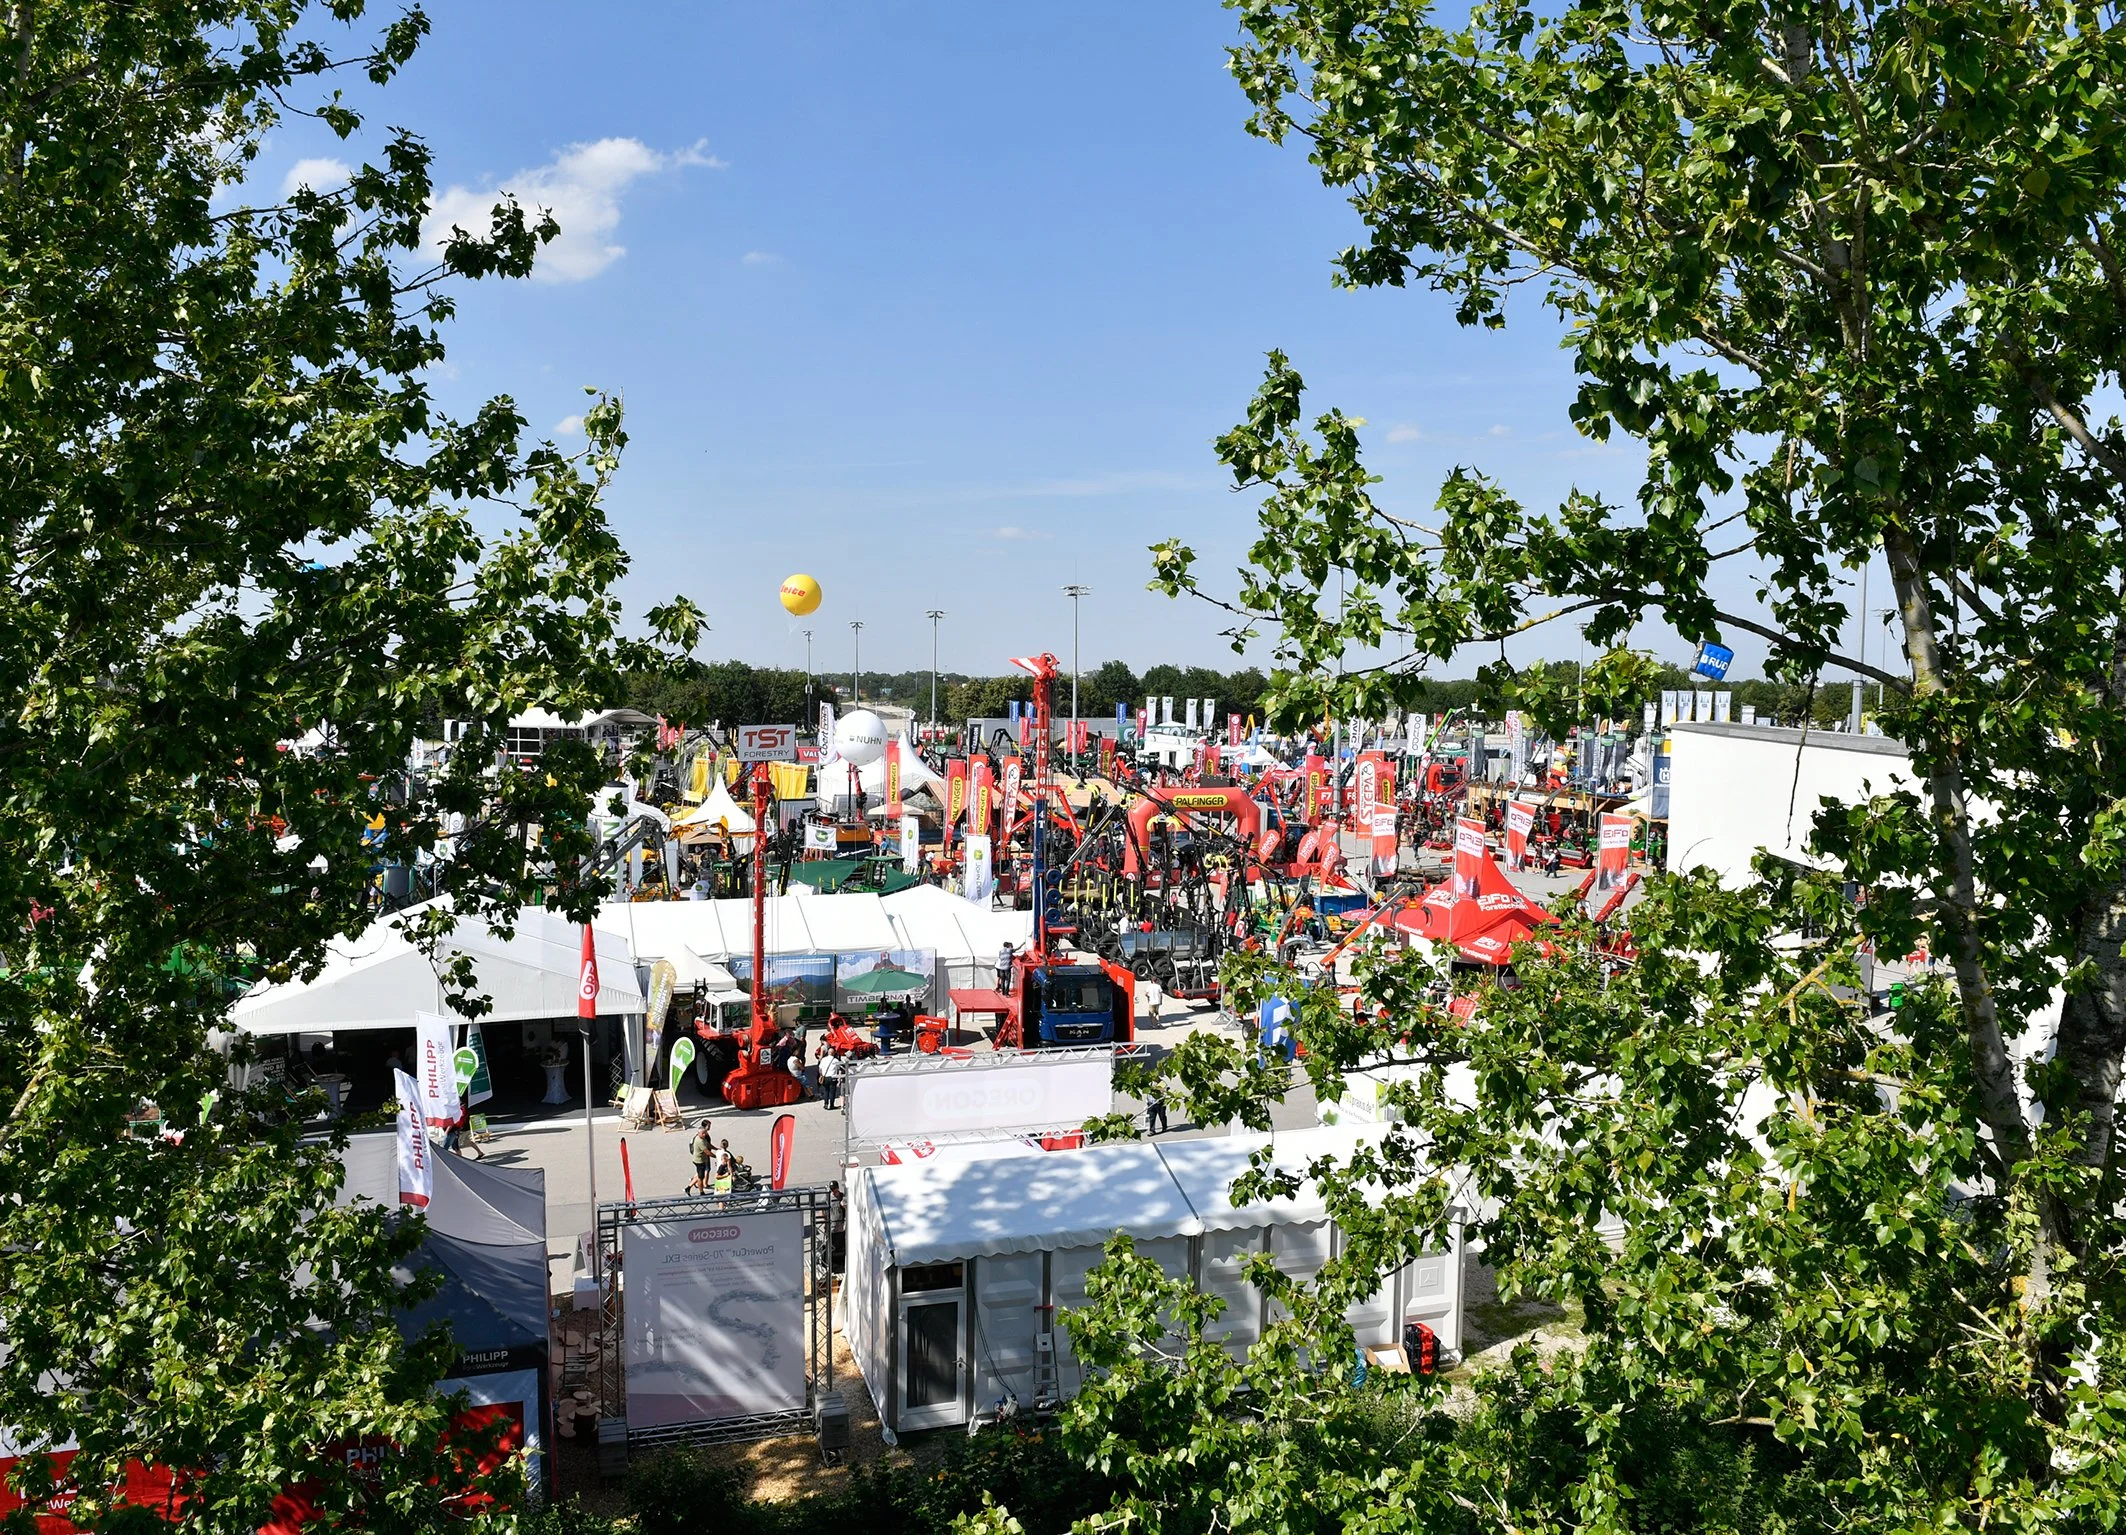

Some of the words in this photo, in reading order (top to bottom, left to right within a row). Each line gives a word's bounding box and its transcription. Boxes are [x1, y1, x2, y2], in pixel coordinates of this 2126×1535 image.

[1707, 657, 1729, 671] RUD
[743, 728, 791, 749] TST
[856, 735, 882, 745] NUHN
[743, 750, 790, 758] FORESTRY
[803, 749, 820, 758] VAL
[1175, 796, 1225, 806] PALFINGER
[1321, 792, 1332, 801] F7
[1347, 792, 1356, 801] F8
[1361, 776, 1374, 820] STEPA
[1005, 781, 1017, 826] STEPA
[848, 992, 922, 1003] TIMBERNAOR
[427, 1040, 439, 1098] PHILIPP
[409, 1102, 424, 1170] PHILIPP
[463, 1350, 508, 1364] PHILIPP
